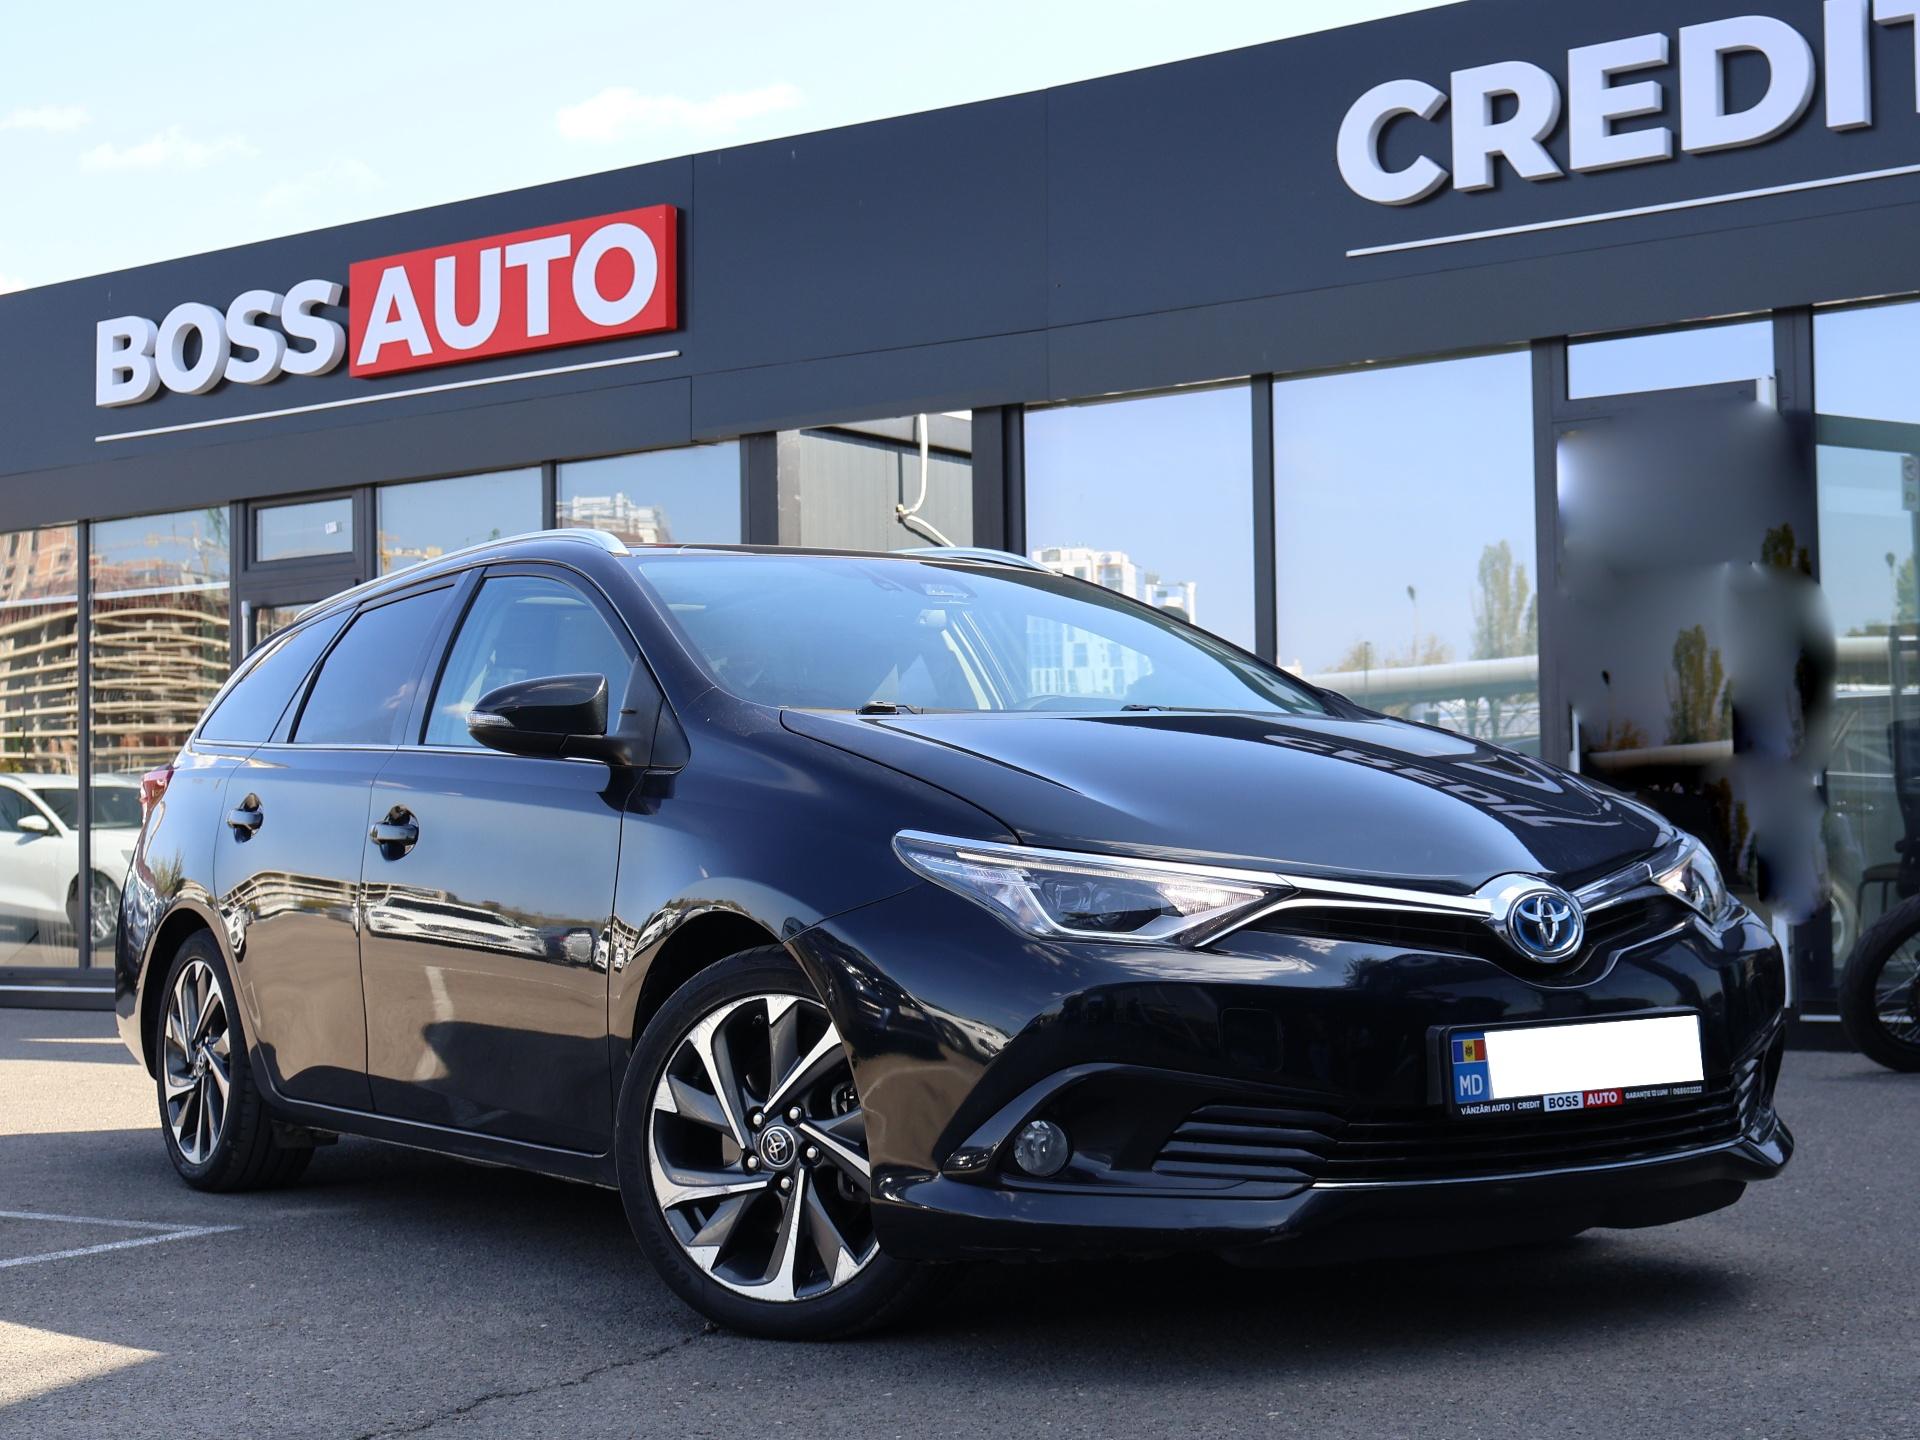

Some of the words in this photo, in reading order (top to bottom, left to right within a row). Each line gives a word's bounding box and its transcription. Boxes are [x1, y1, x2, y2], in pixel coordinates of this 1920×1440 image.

[96, 279, 346, 408] BOSS
[356, 222, 659, 366] AUTO
[1460, 1074, 1483, 1097] MD
[1491, 1103, 1510, 1112] AUTO
[1517, 1101, 1540, 1110] CREDIT
[1548, 1095, 1579, 1109] BOSS
[1586, 1091, 1618, 1105] AUTO
